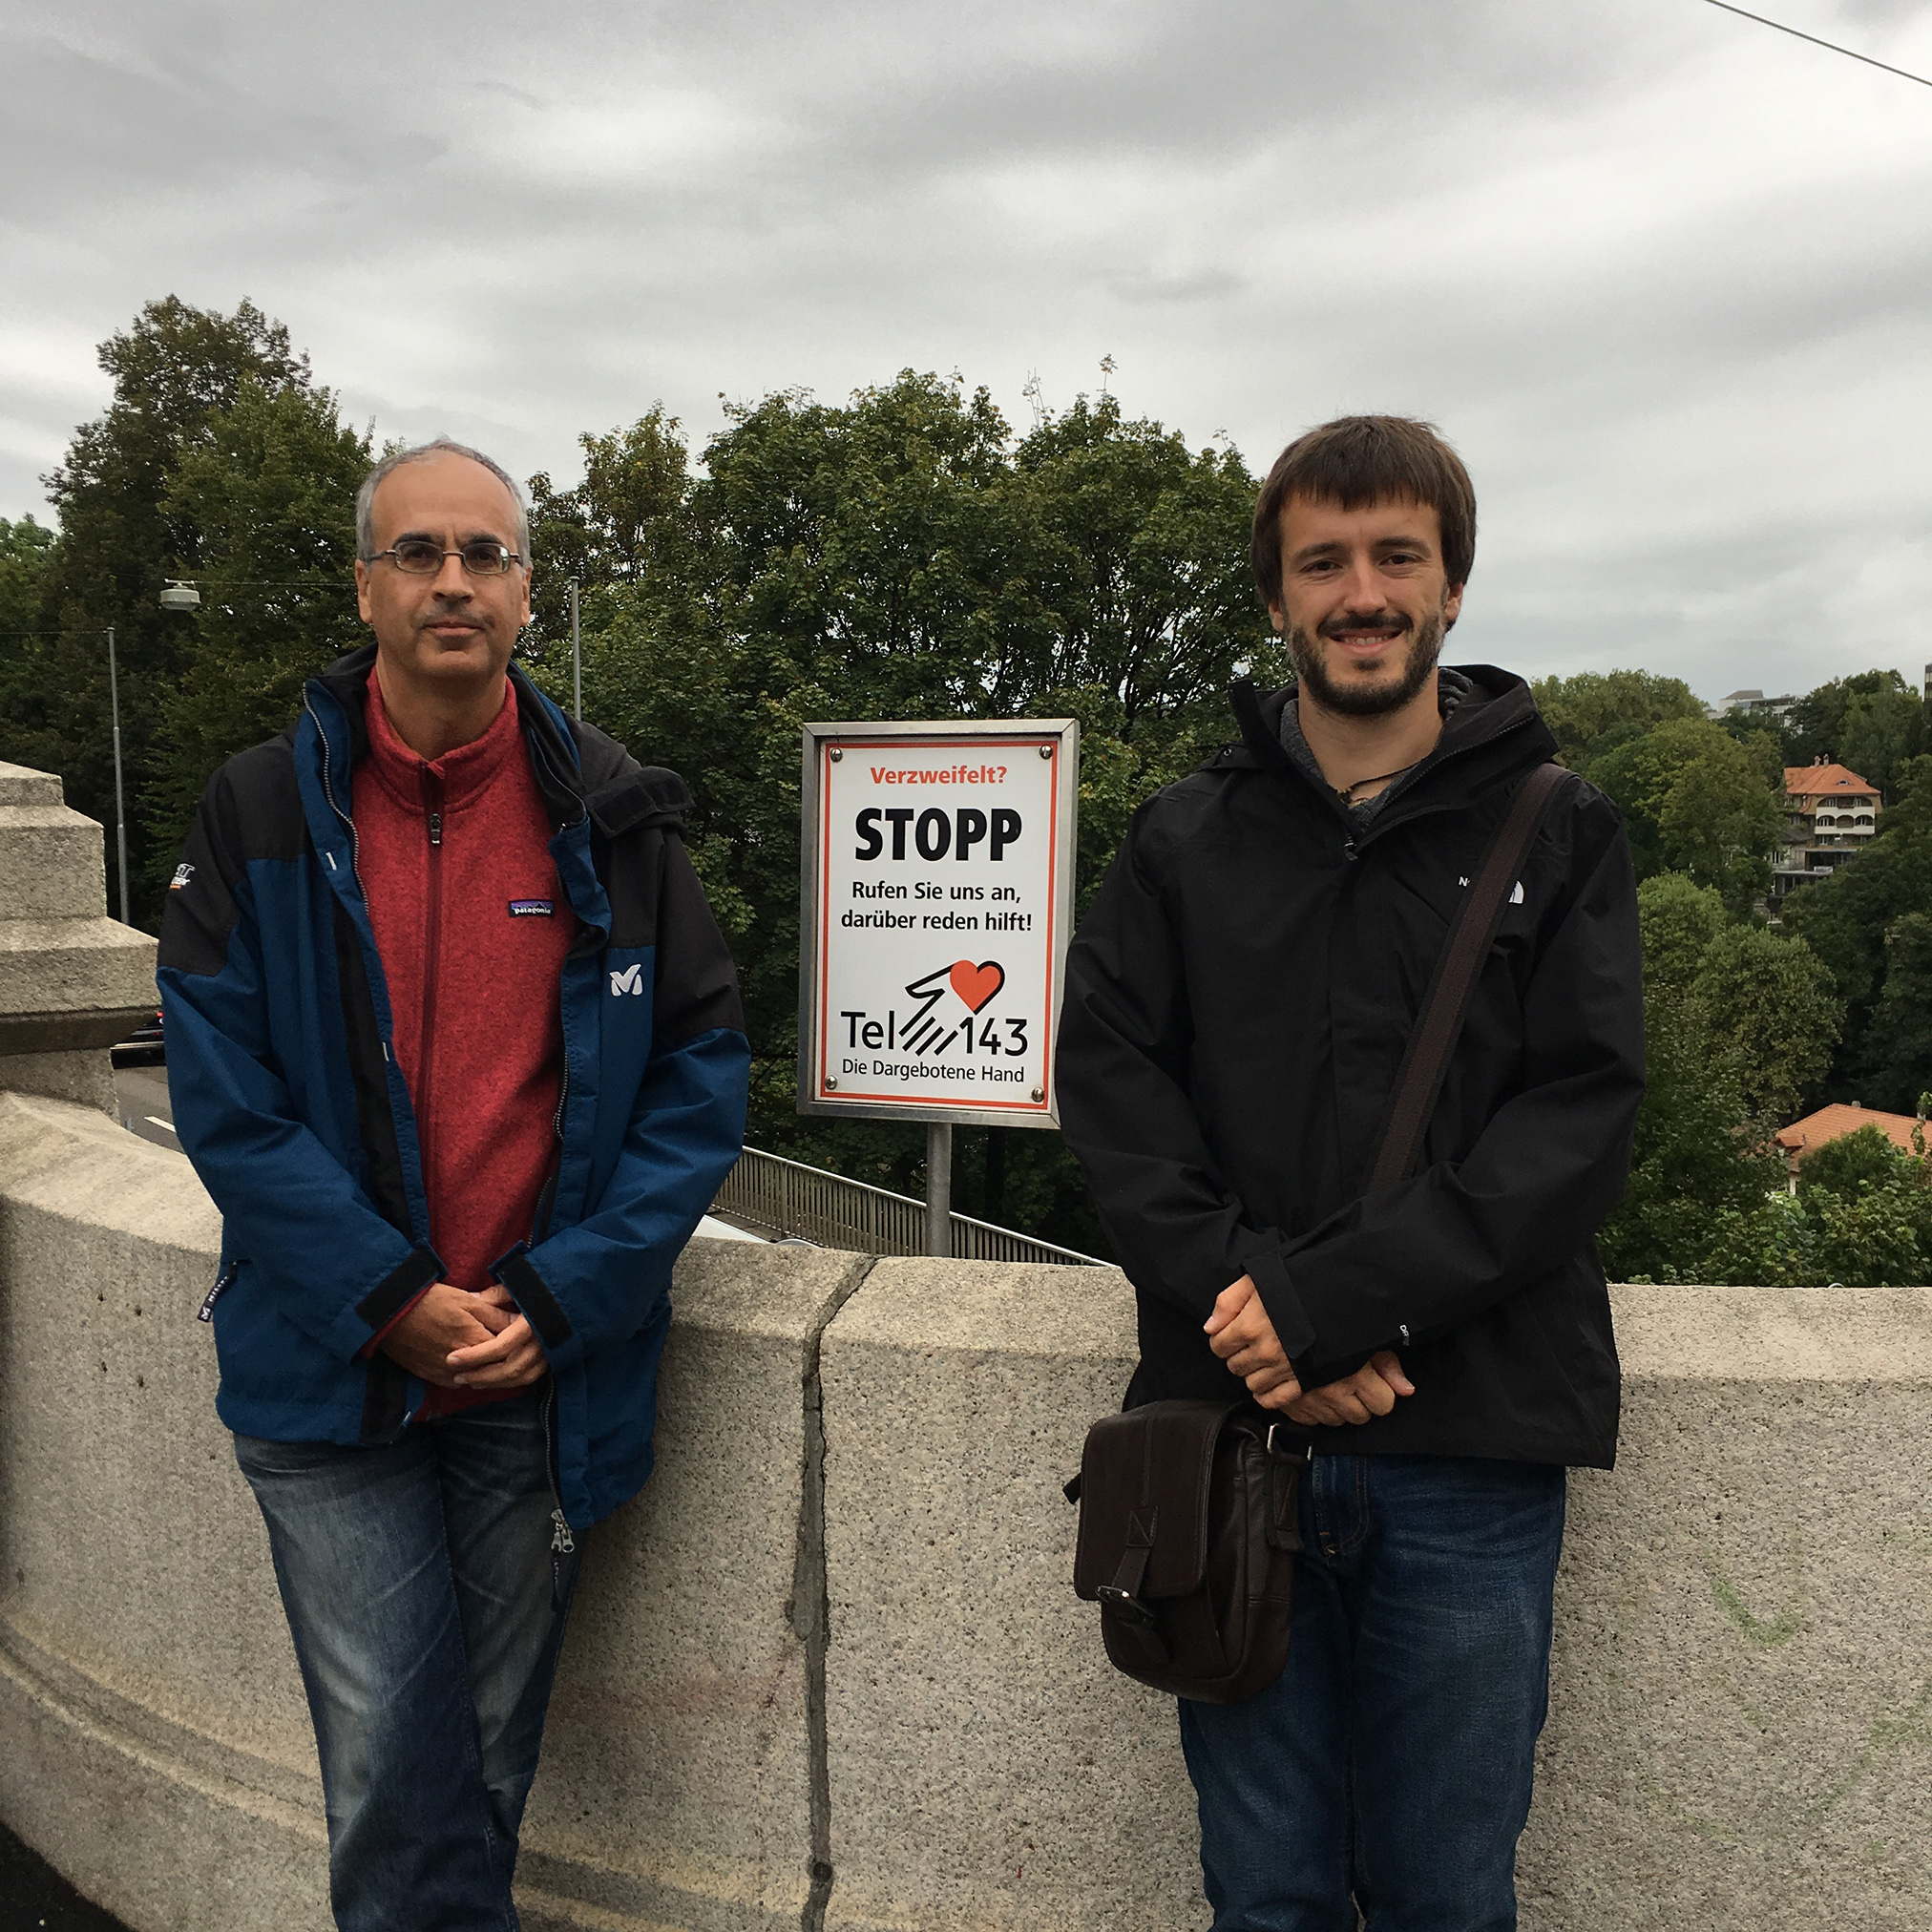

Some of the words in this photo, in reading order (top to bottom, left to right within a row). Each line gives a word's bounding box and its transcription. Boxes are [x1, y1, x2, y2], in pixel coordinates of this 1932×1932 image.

[870, 765, 1007, 785] Verzweifelt?
[854, 807, 1022, 862] STOPP
[852, 880, 908, 900] Rufen
[914, 881, 943, 900] Sie
[950, 886, 985, 901] uns
[991, 885, 1021, 904] an,
[514, 907, 552, 915] patagonia
[841, 909, 917, 929] darüber
[922, 913, 978, 931] reden
[985, 912, 1032, 932] hilft!
[840, 1010, 895, 1050] Tel
[958, 1017, 1029, 1057] 143
[842, 1058, 868, 1076] Die
[872, 1060, 976, 1082] Dargebotene
[981, 1065, 1024, 1083] Hand
